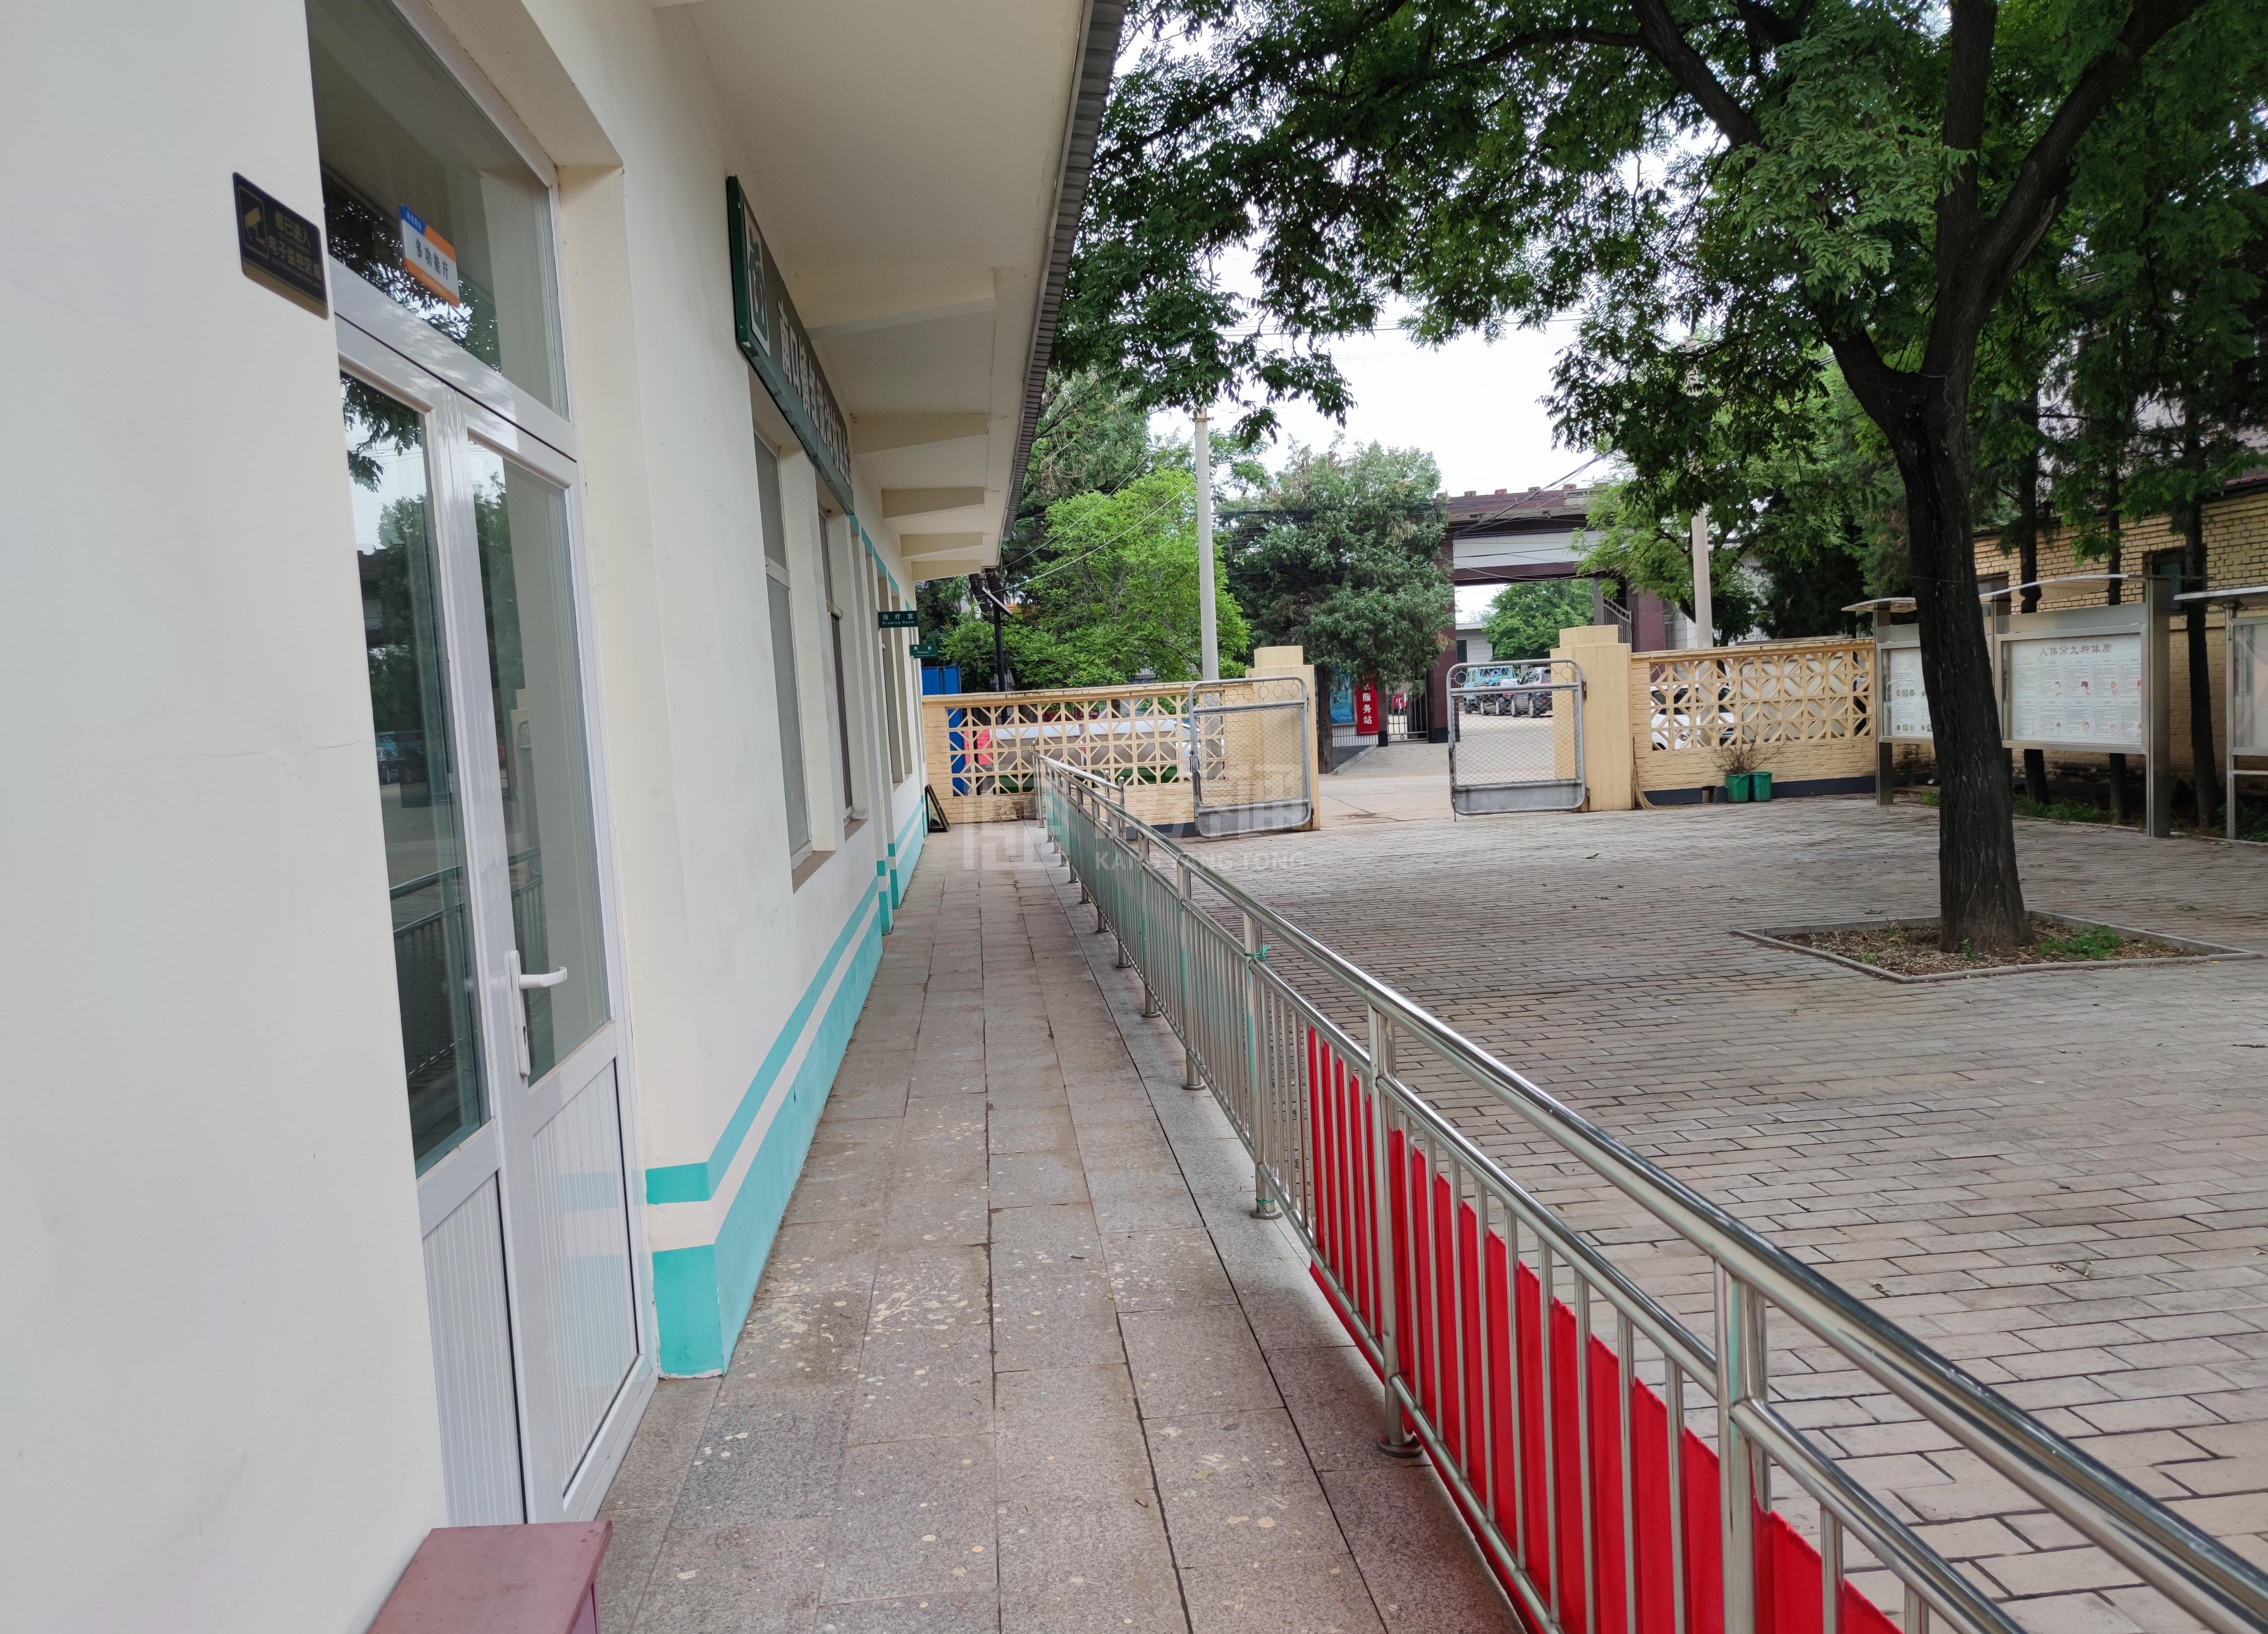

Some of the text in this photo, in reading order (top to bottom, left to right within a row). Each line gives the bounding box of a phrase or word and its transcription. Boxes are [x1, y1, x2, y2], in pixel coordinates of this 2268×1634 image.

[416, 238, 448, 280] 多功能厅
[2039, 644, 2112, 656] 人体分九种体质
[1362, 674, 1372, 725] 区服务站
